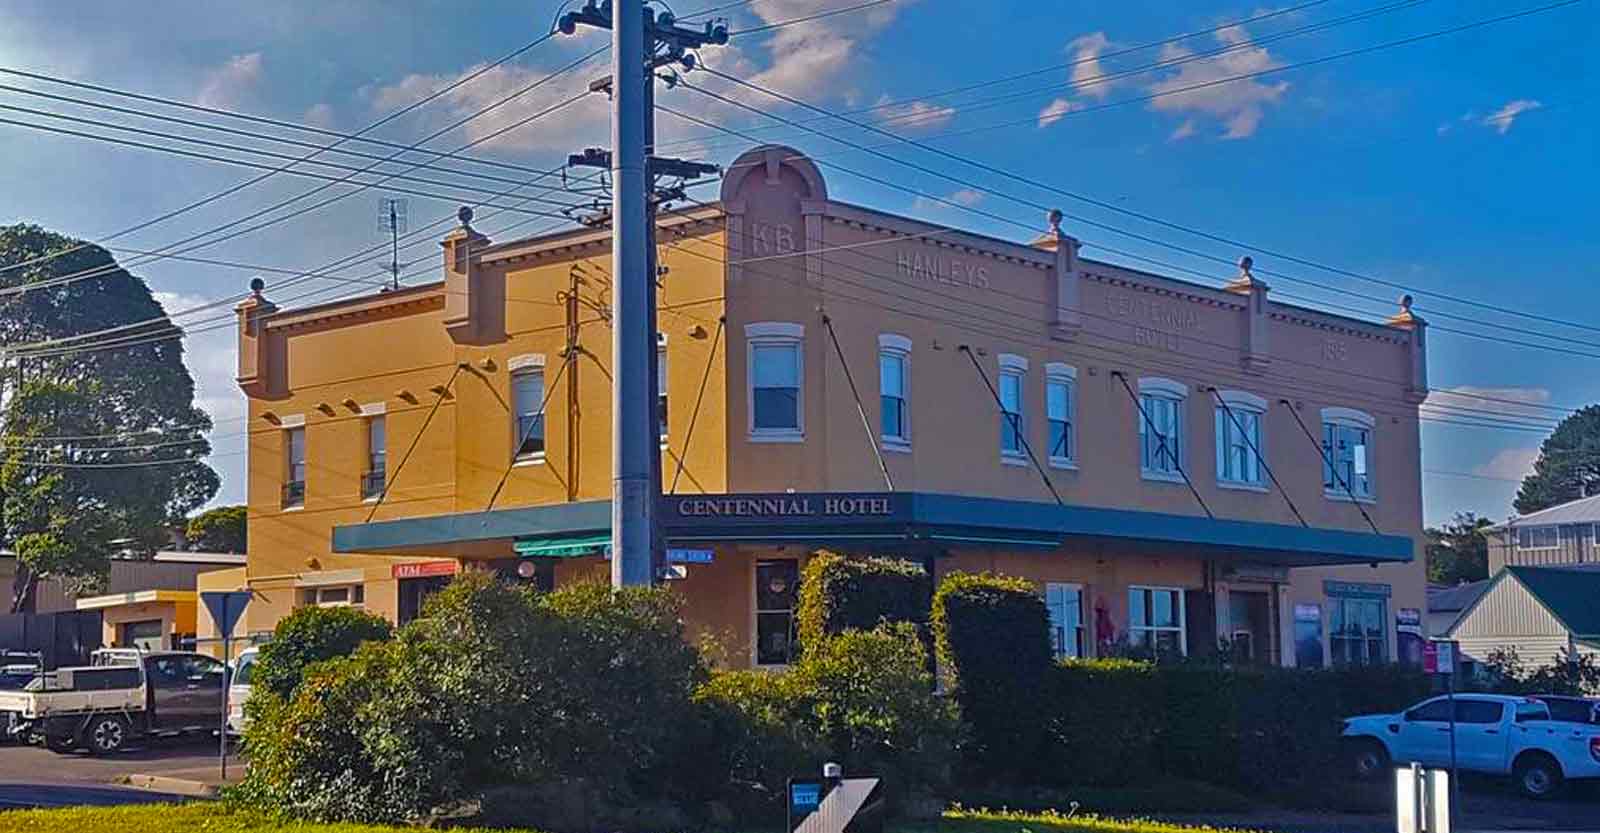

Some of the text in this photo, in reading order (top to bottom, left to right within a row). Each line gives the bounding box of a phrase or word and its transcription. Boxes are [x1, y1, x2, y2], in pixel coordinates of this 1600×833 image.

[895, 249, 991, 290] HANLEYS
[679, 497, 893, 516] CENTENNIAL HOTEL
[395, 565, 422, 578] ATM
